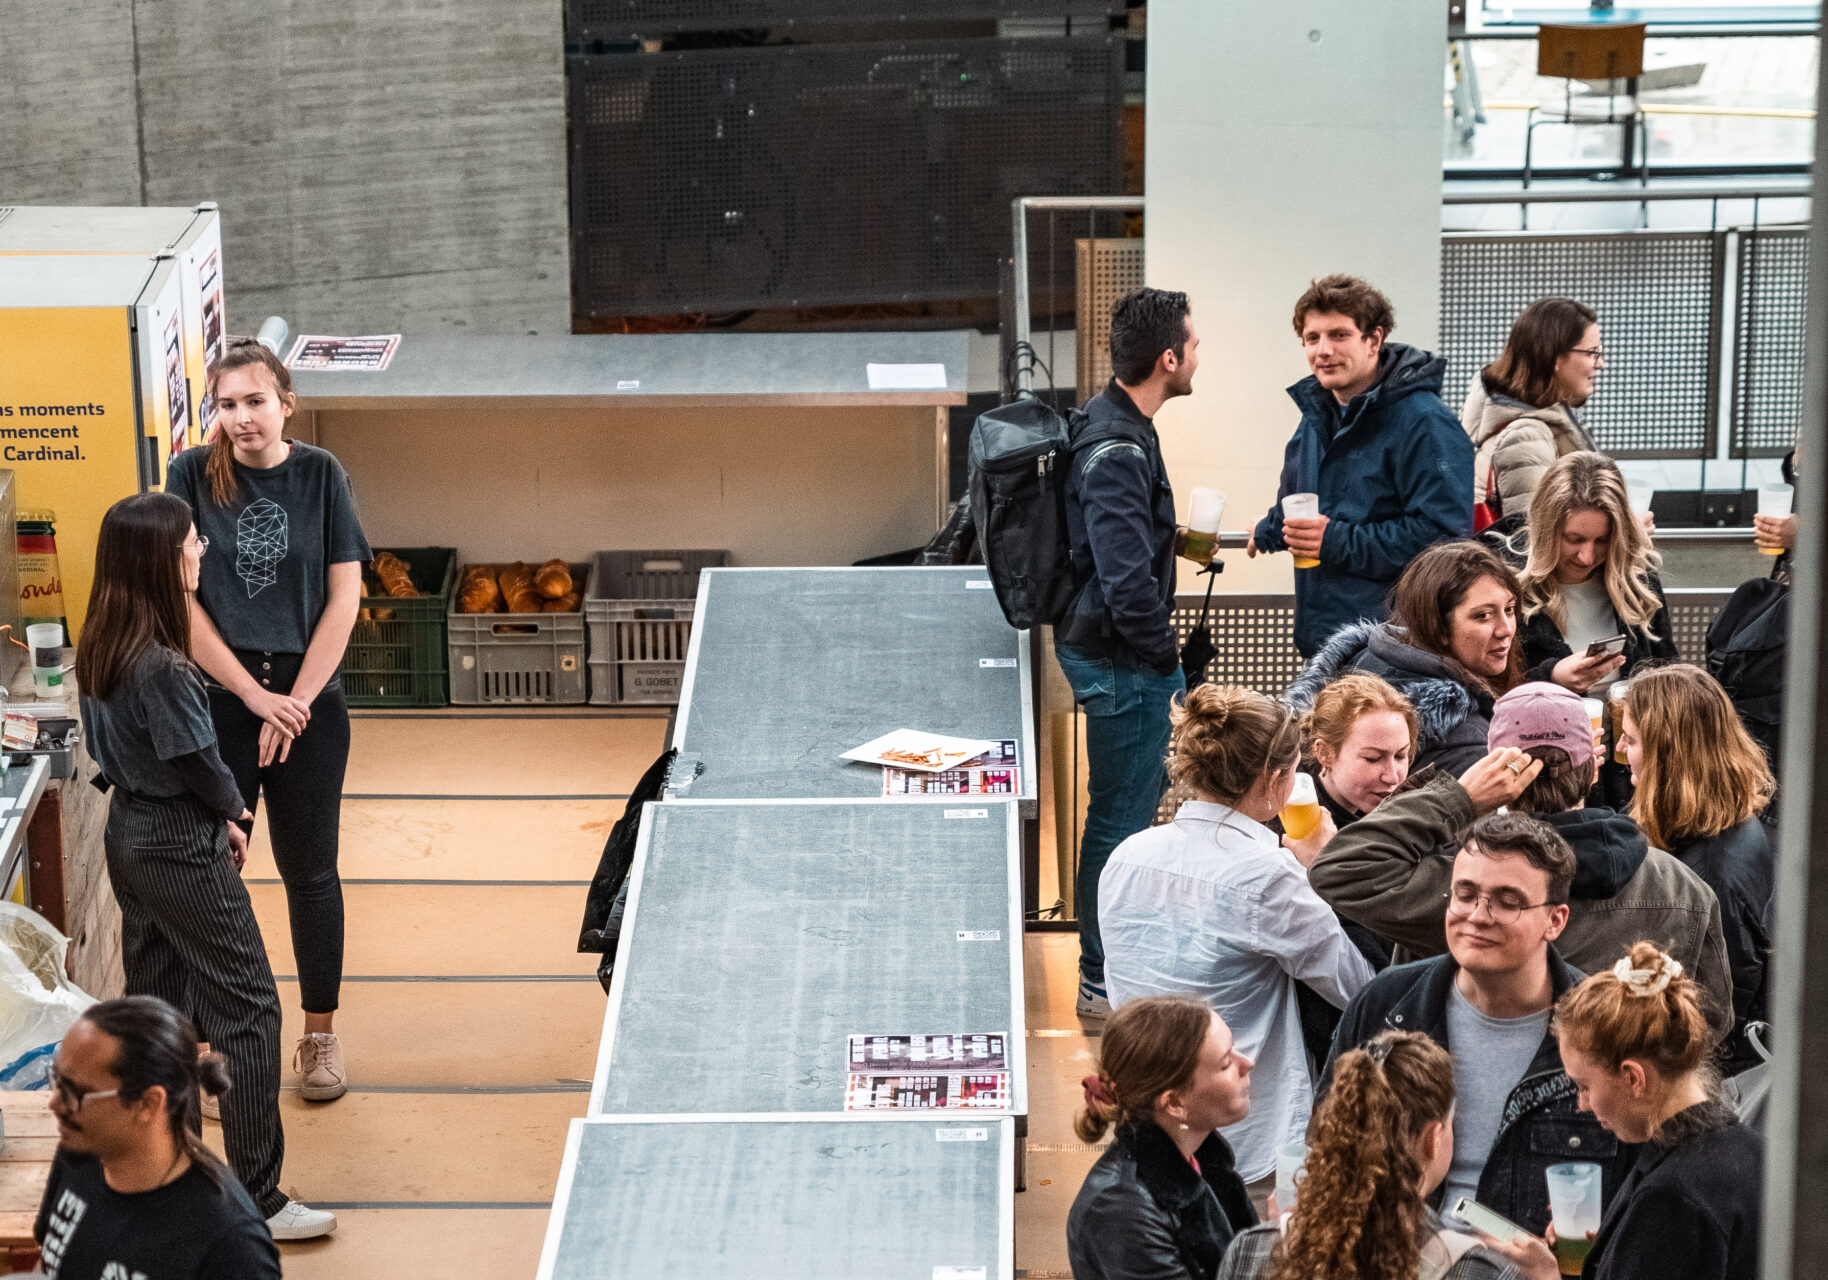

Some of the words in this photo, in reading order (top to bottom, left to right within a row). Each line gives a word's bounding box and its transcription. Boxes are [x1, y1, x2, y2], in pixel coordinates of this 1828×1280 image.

[19, 402, 105, 416] moments
[0, 425, 79, 439] mencent
[4, 445, 86, 461] Cardinal.
[645, 677, 679, 686] GOBET
